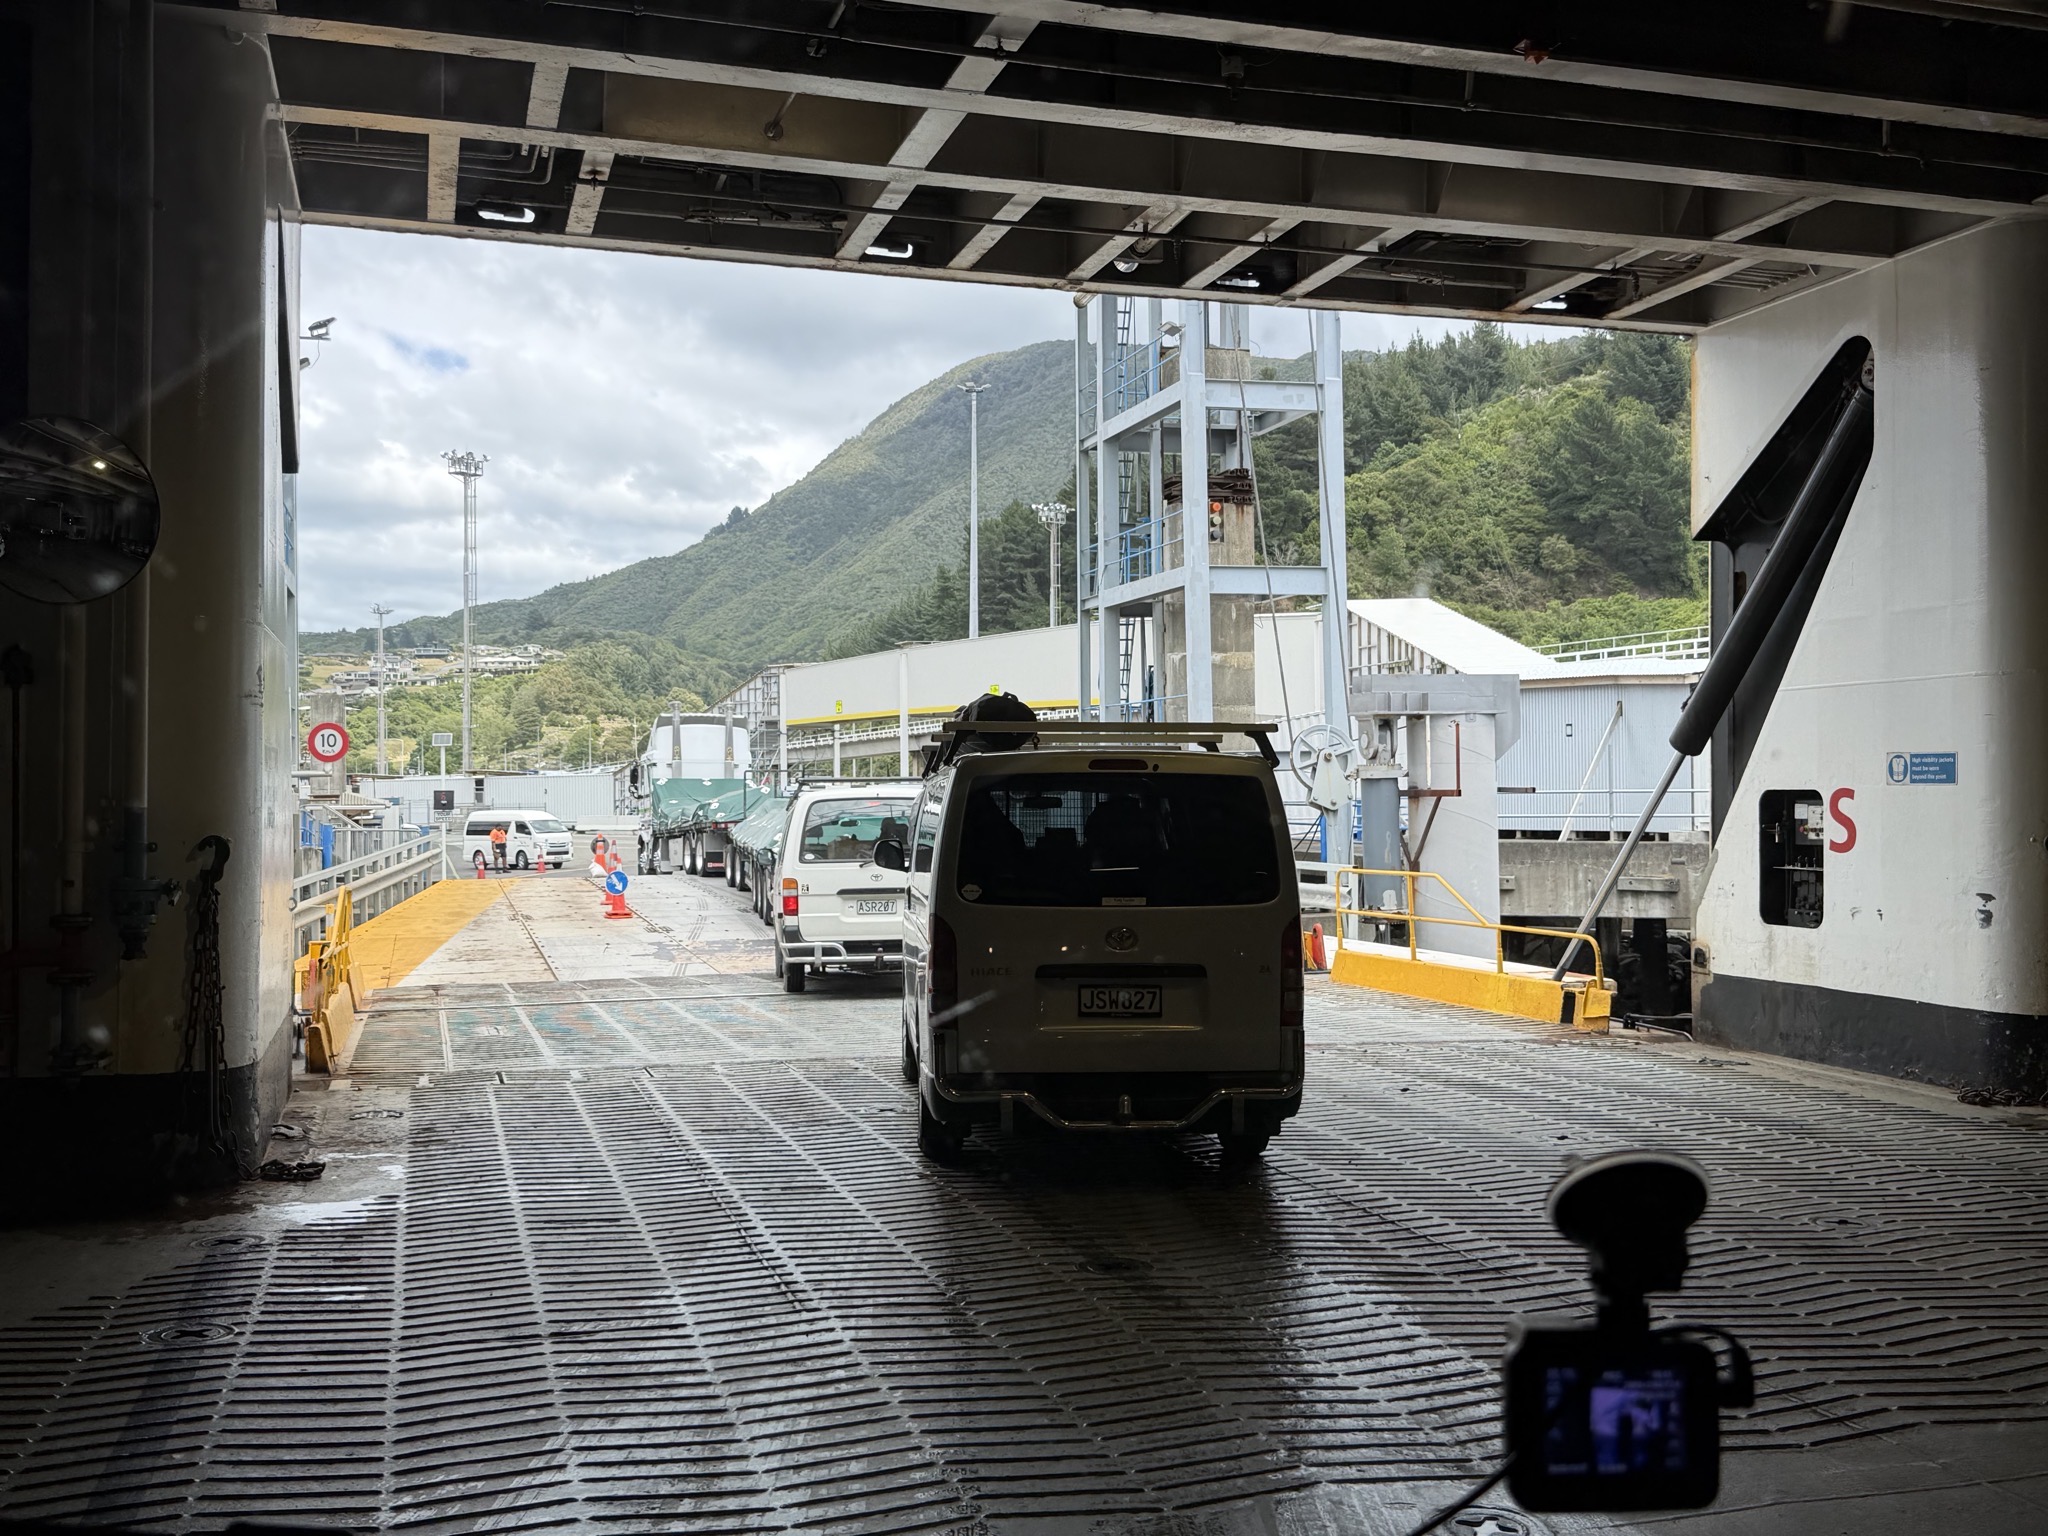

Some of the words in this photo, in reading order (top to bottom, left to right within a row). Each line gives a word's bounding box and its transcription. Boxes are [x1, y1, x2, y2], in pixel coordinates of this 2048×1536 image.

[320, 733, 337, 748] 10
[1911, 756, 1921, 764] High
[1921, 756, 1938, 764] visibility
[1829, 787, 1857, 854] S
[858, 901, 896, 912] ASR207
[970, 967, 1014, 977] HIACE
[1083, 990, 1158, 1010] JSW827
